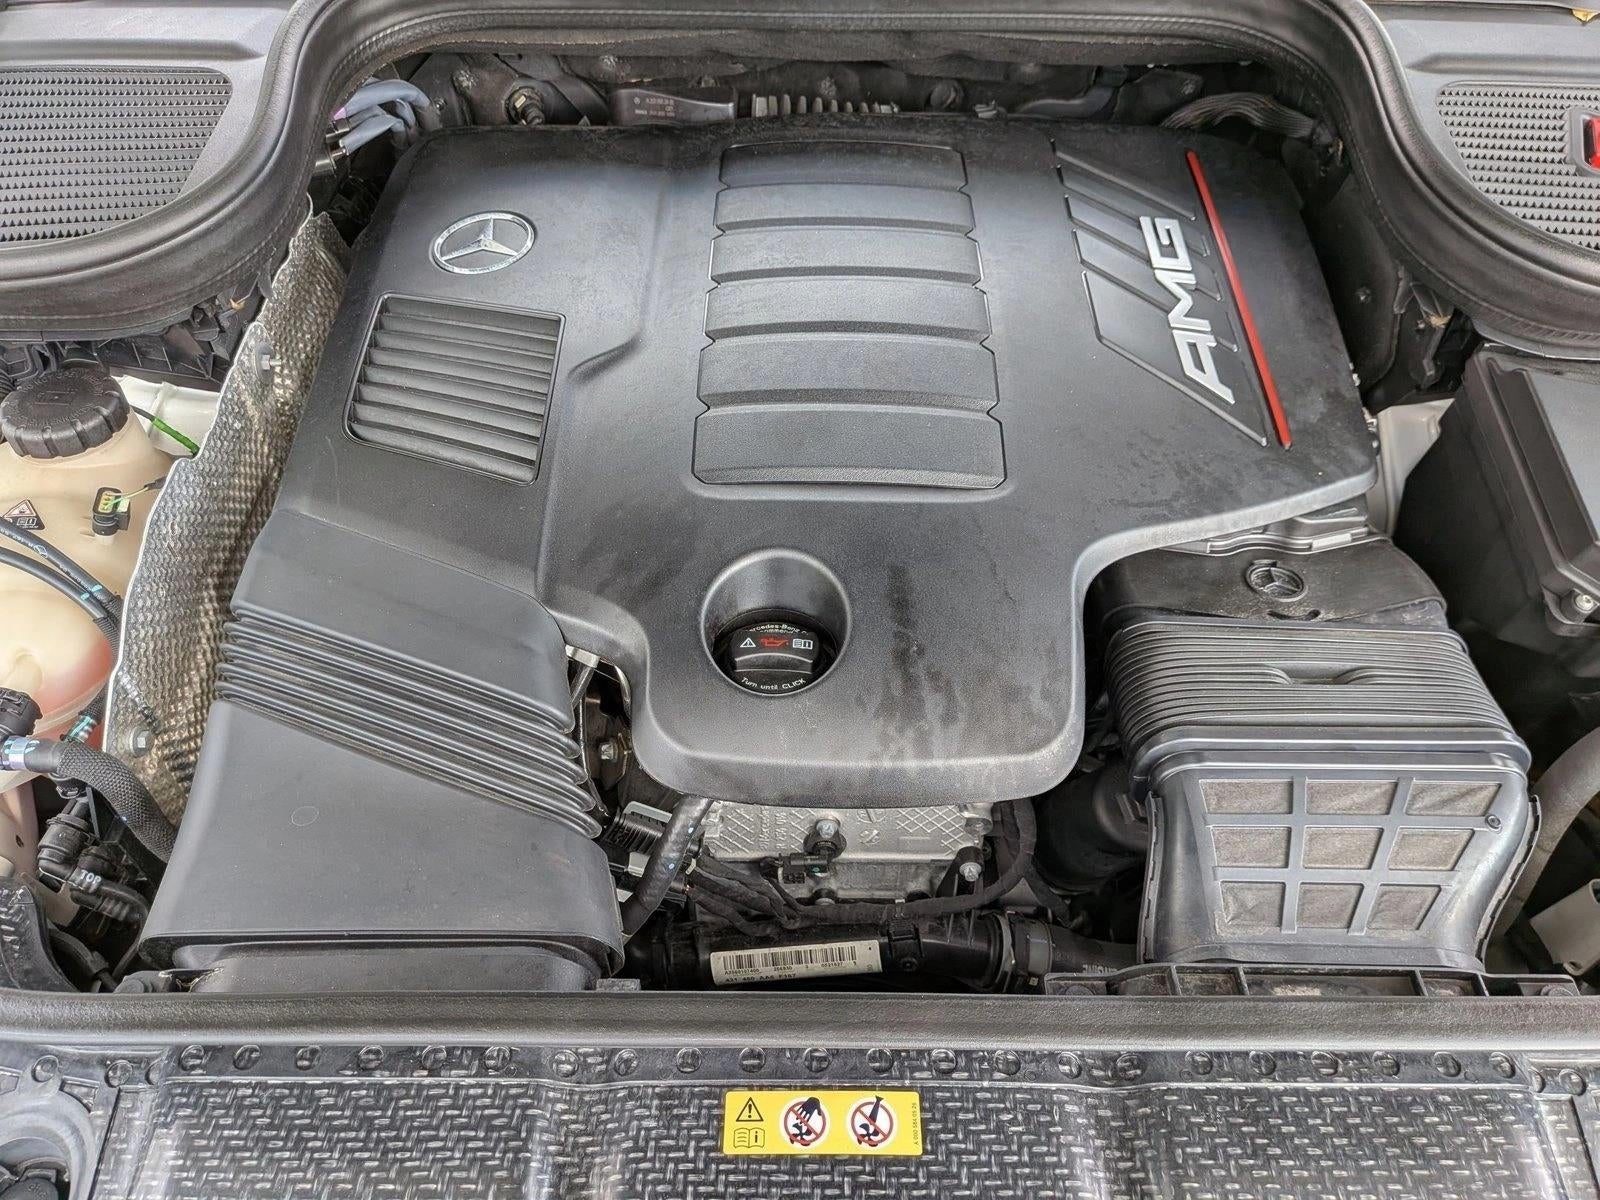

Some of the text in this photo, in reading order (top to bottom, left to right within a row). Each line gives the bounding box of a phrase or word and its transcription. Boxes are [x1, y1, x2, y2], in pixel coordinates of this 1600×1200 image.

[1139, 216, 1235, 404] AMG
[742, 677, 757, 687] Turn
[782, 678, 806, 689] CLICK
[80, 869, 102, 884] TOP
